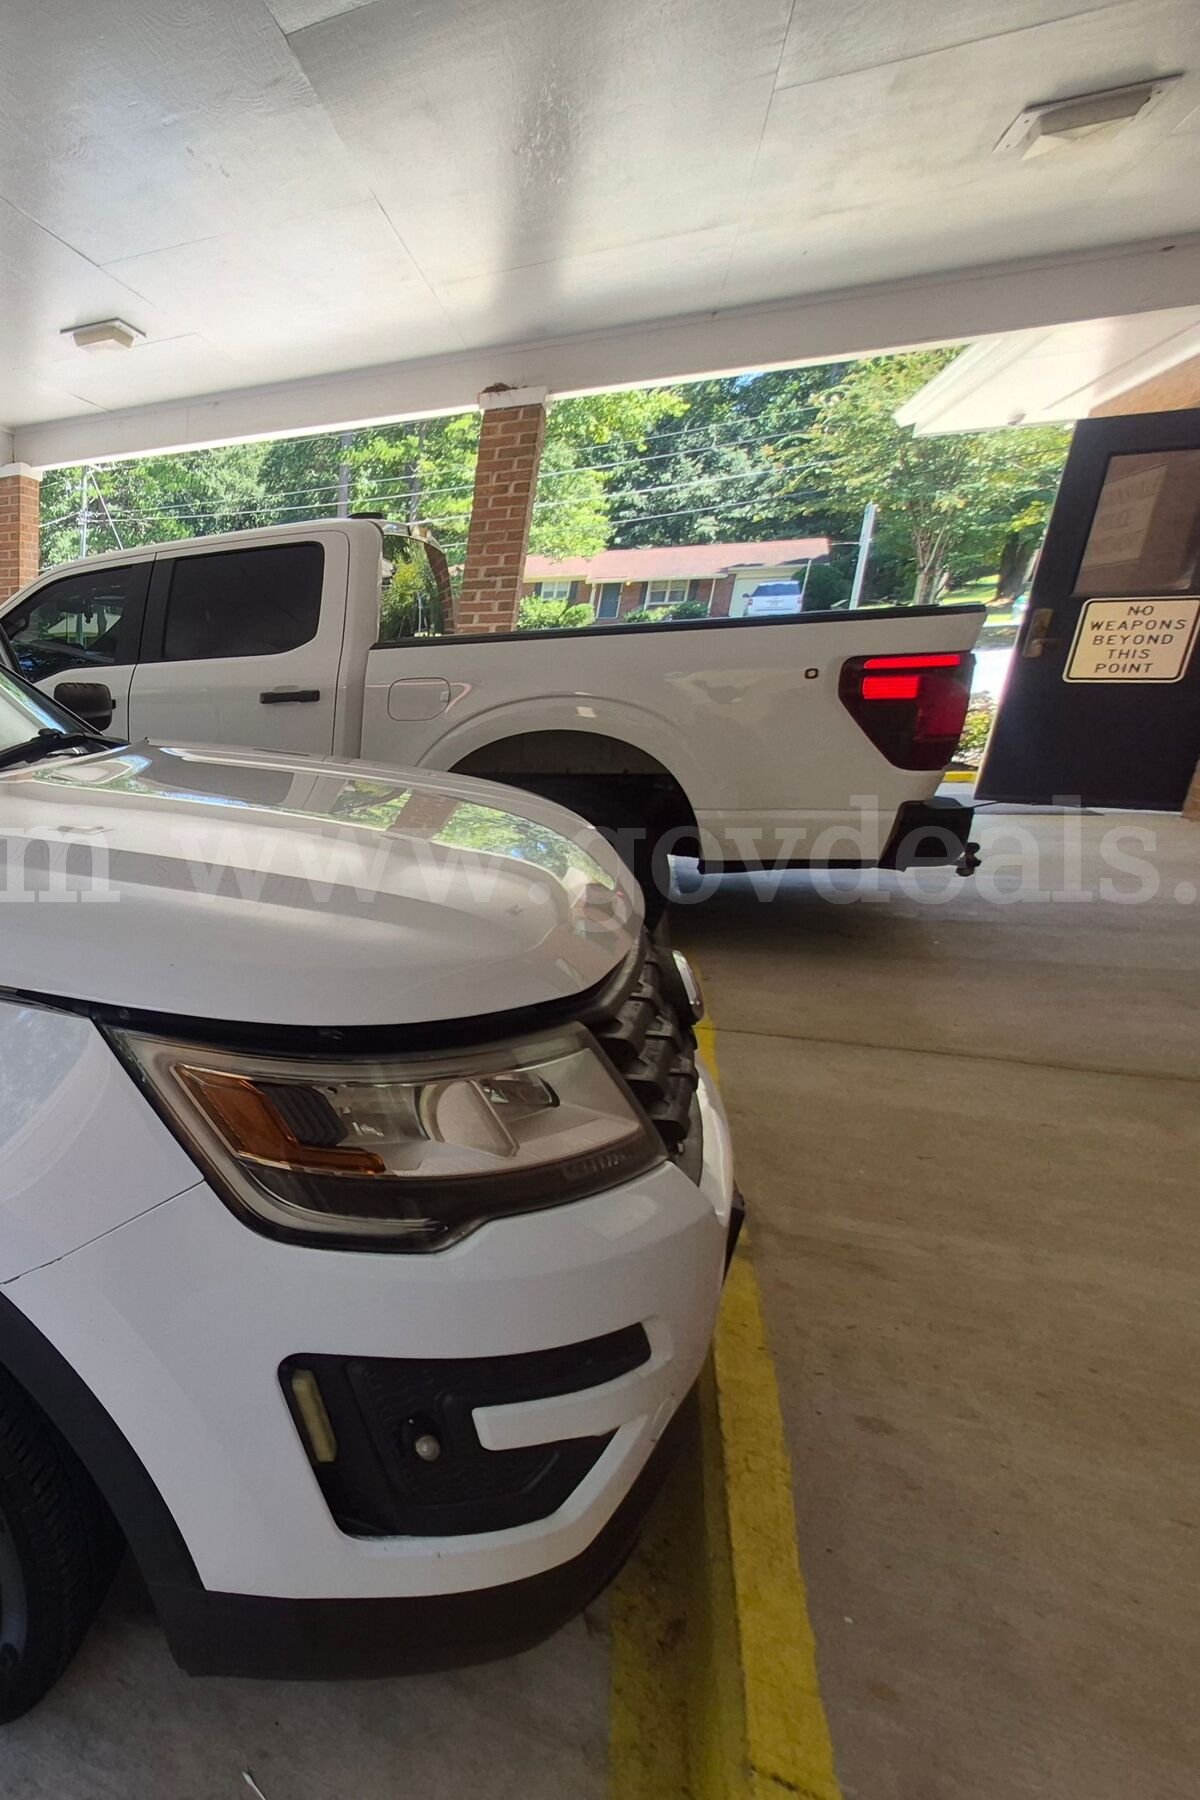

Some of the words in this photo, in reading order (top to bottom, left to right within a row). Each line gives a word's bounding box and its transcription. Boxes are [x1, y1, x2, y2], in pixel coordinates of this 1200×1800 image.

[1127, 605, 1154, 616] NO
[1091, 619, 1186, 631] WEAPONS
[1093, 634, 1173, 645] BEYOND
[1108, 649, 1150, 659] THIS
[1095, 663, 1153, 673] POINT
